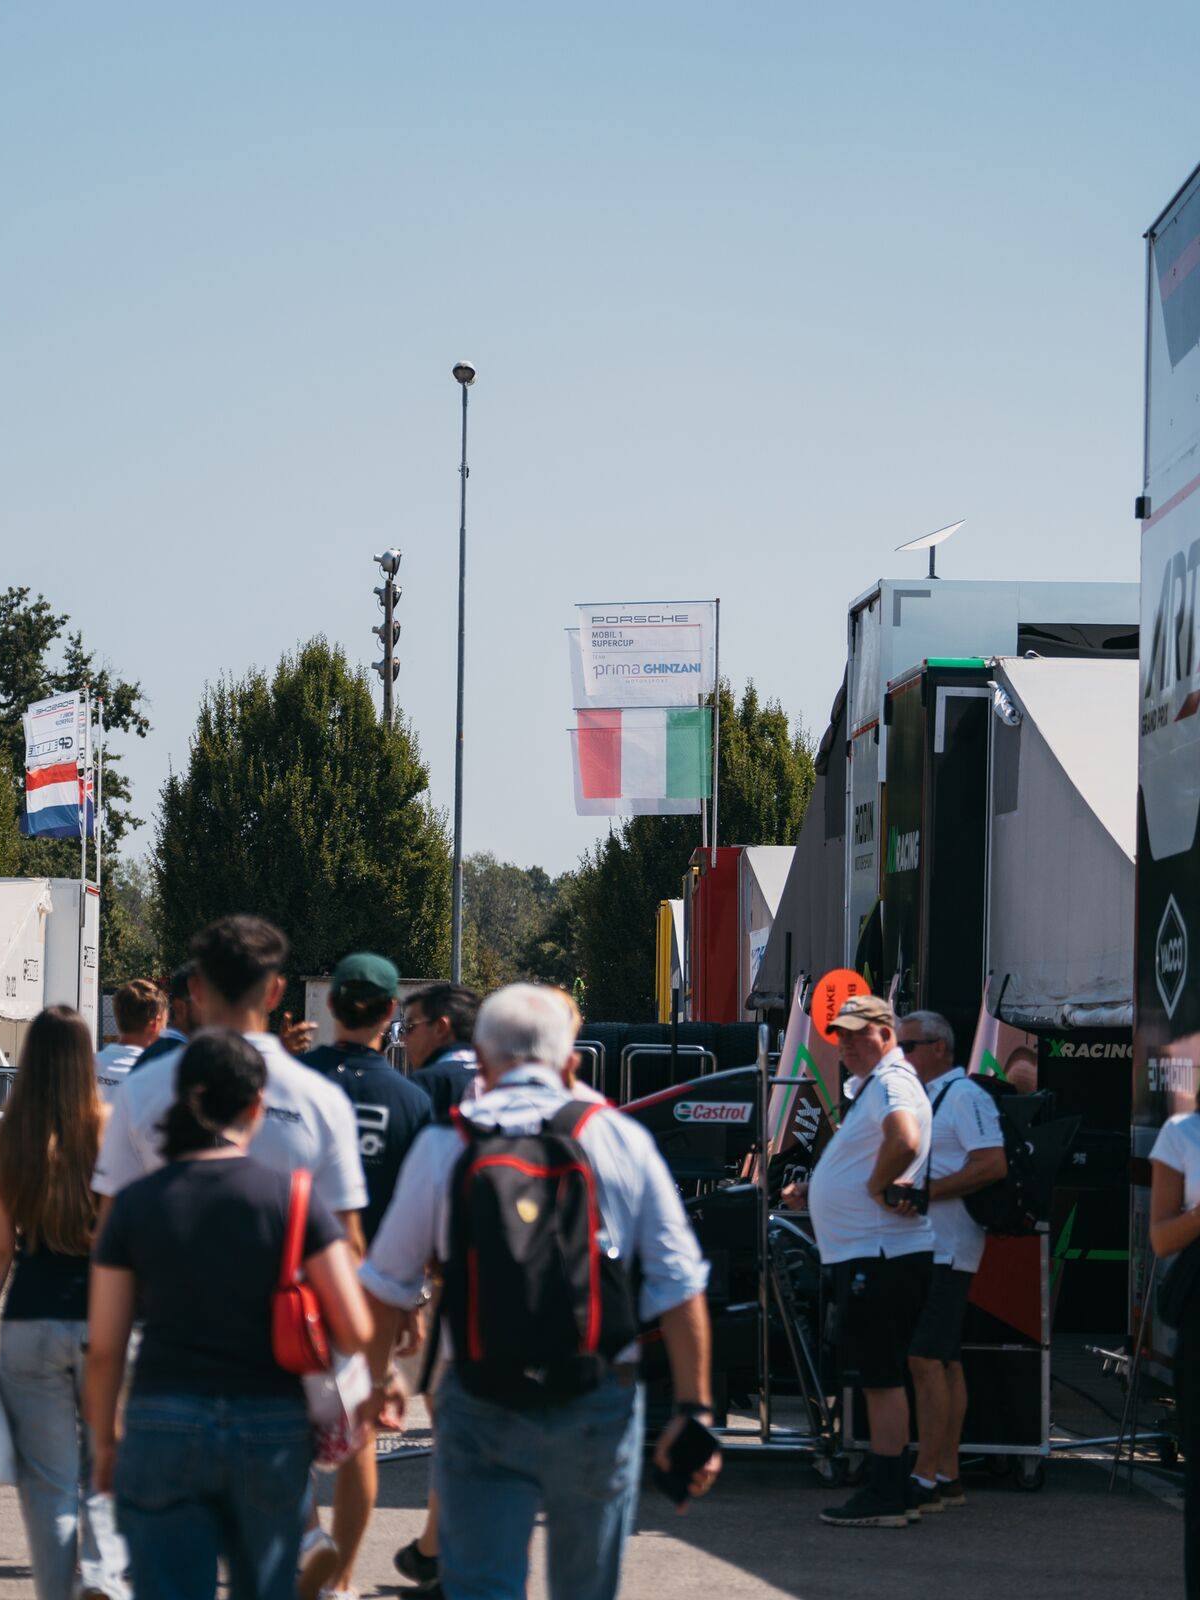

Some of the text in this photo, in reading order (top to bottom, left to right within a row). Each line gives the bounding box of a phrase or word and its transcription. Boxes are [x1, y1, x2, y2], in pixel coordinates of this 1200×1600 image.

[592, 614, 689, 623] PORSCHE
[591, 631, 617, 639] MOBIL
[591, 639, 634, 647] SUPERCUP
[593, 663, 702, 679] prima GHINZANI
[1160, 936, 1183, 974] YACCO
[826, 984, 836, 1027] RAKE
[692, 1104, 746, 1120] Castrol
